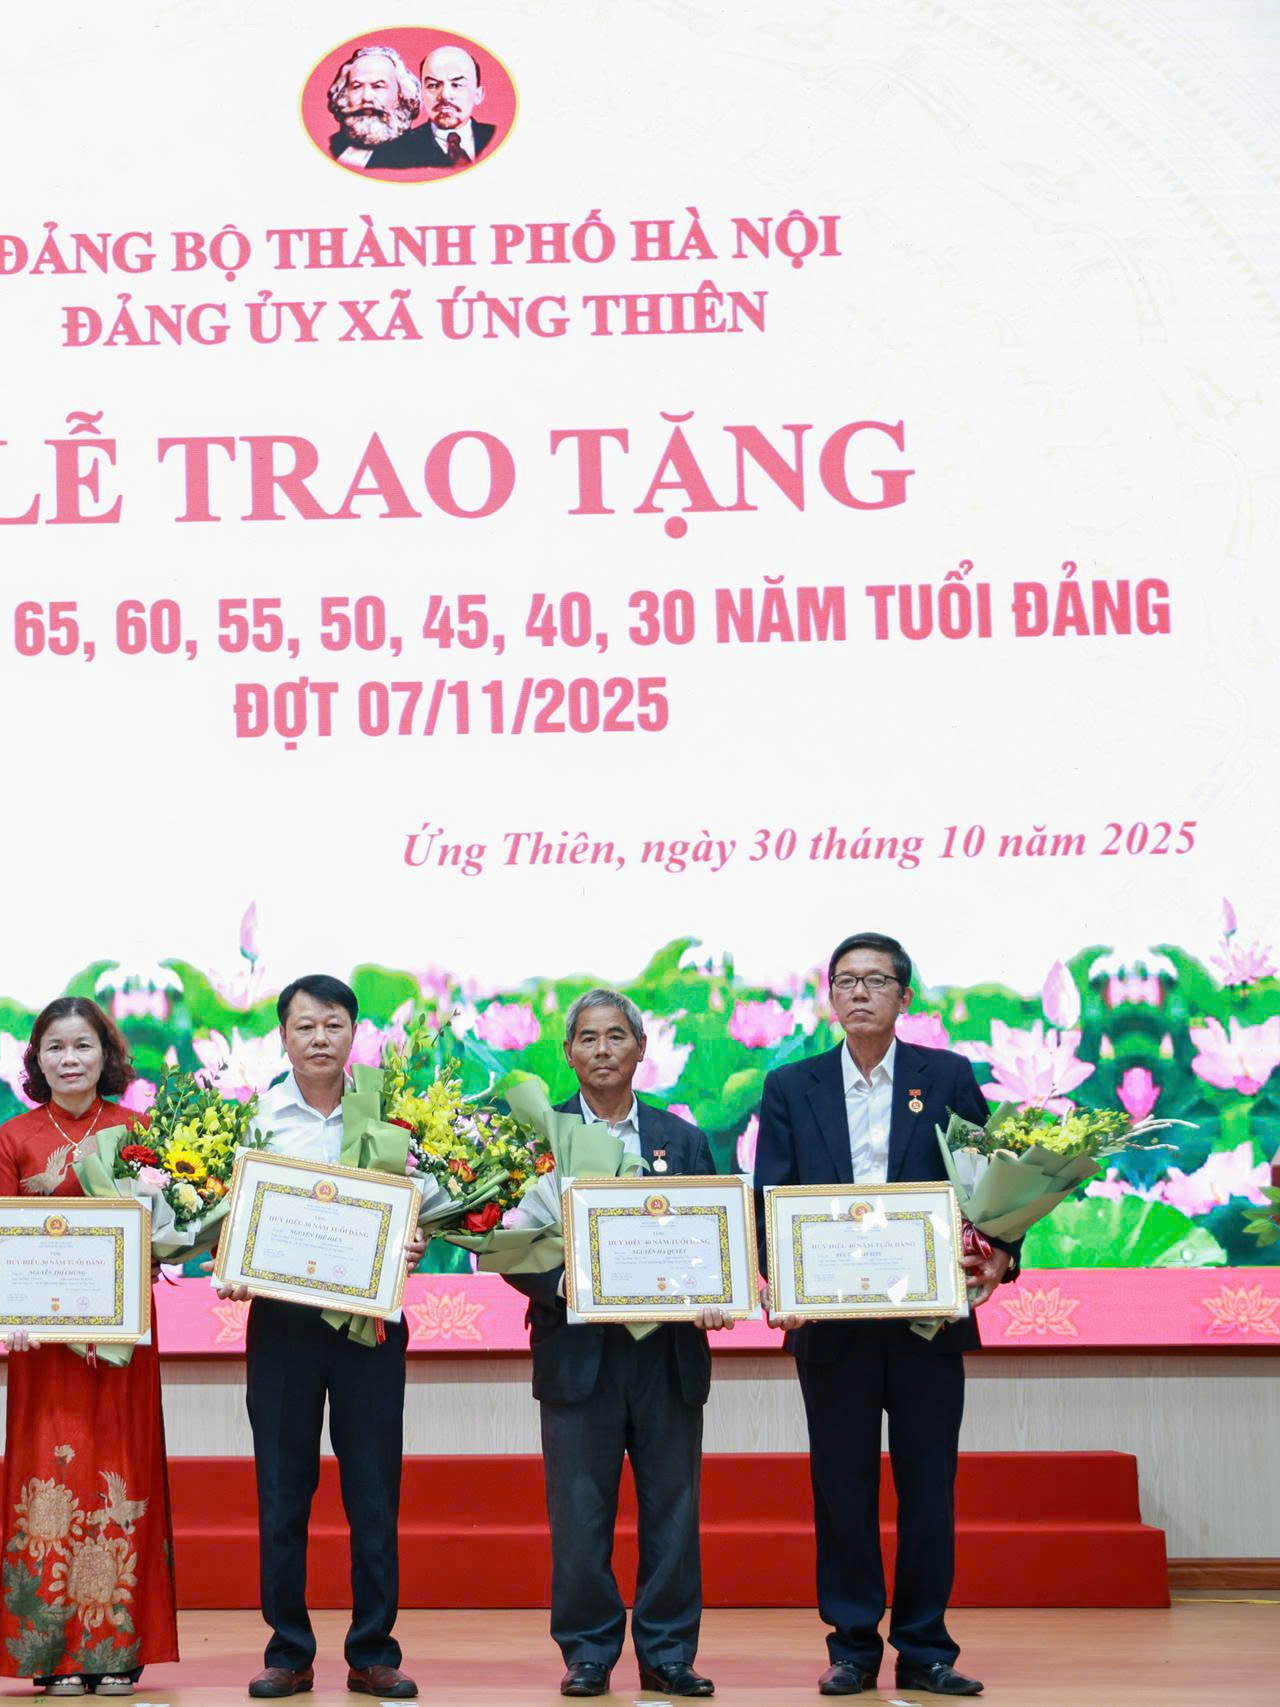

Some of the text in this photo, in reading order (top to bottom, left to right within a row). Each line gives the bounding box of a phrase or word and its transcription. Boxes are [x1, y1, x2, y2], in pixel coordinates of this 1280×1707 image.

[172, 229, 252, 283] BỘ
[265, 214, 476, 271] THÀNH
[490, 208, 617, 265] PHỐ
[629, 206, 718, 262] HÀ
[730, 208, 841, 270] NỘI
[63, 279, 769, 348] ĐẢNG ỦY XÃ ỨNG THIÊN
[157, 429, 516, 523] TRAO
[549, 410, 916, 540] TẶNG
[14, 600, 96, 662] 65,
[116, 598, 198, 661] 60,
[218, 597, 300, 659] 55,
[319, 596, 403, 657] 50,
[422, 594, 506, 656] 45,
[525, 592, 609, 654] 40,
[628, 588, 696, 647] 30
[714, 575, 847, 644] NĂM
[865, 559, 993, 641] TUỔI
[1011, 560, 1172, 638] ĐẢNG
[233, 675, 669, 752] ĐỢT 07/11/2025
[402, 820, 1198, 876] Ứng Thiên, ngày 30 tháng 10 năm 2025
